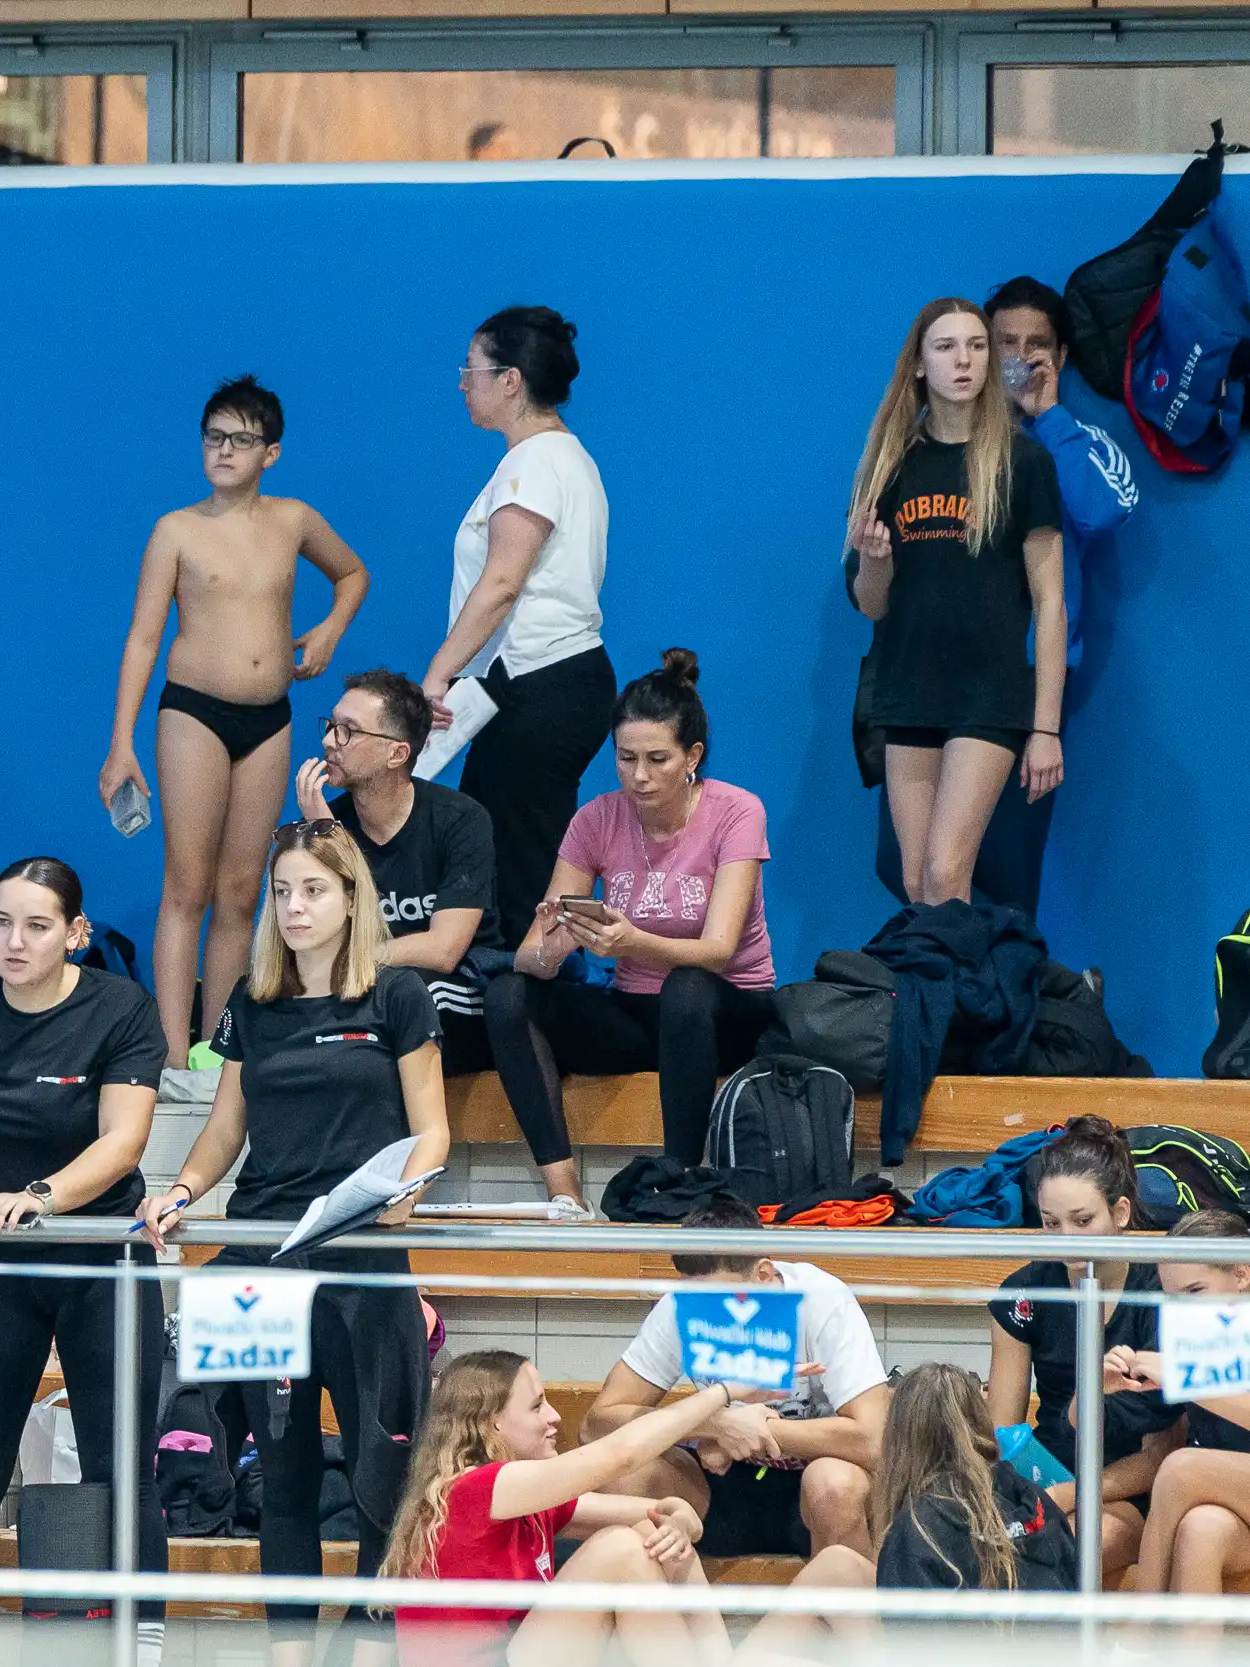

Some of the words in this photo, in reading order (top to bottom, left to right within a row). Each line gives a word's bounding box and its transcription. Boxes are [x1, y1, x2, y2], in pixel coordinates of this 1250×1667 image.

[895, 494, 972, 535] DUBRAV
[901, 524, 967, 543] Swimming
[379, 891, 437, 921] das
[610, 871, 707, 920] GAP
[194, 1343, 296, 1370] Zadar
[688, 1341, 791, 1387] Zadar
[1177, 1354, 1249, 1390] Zad
